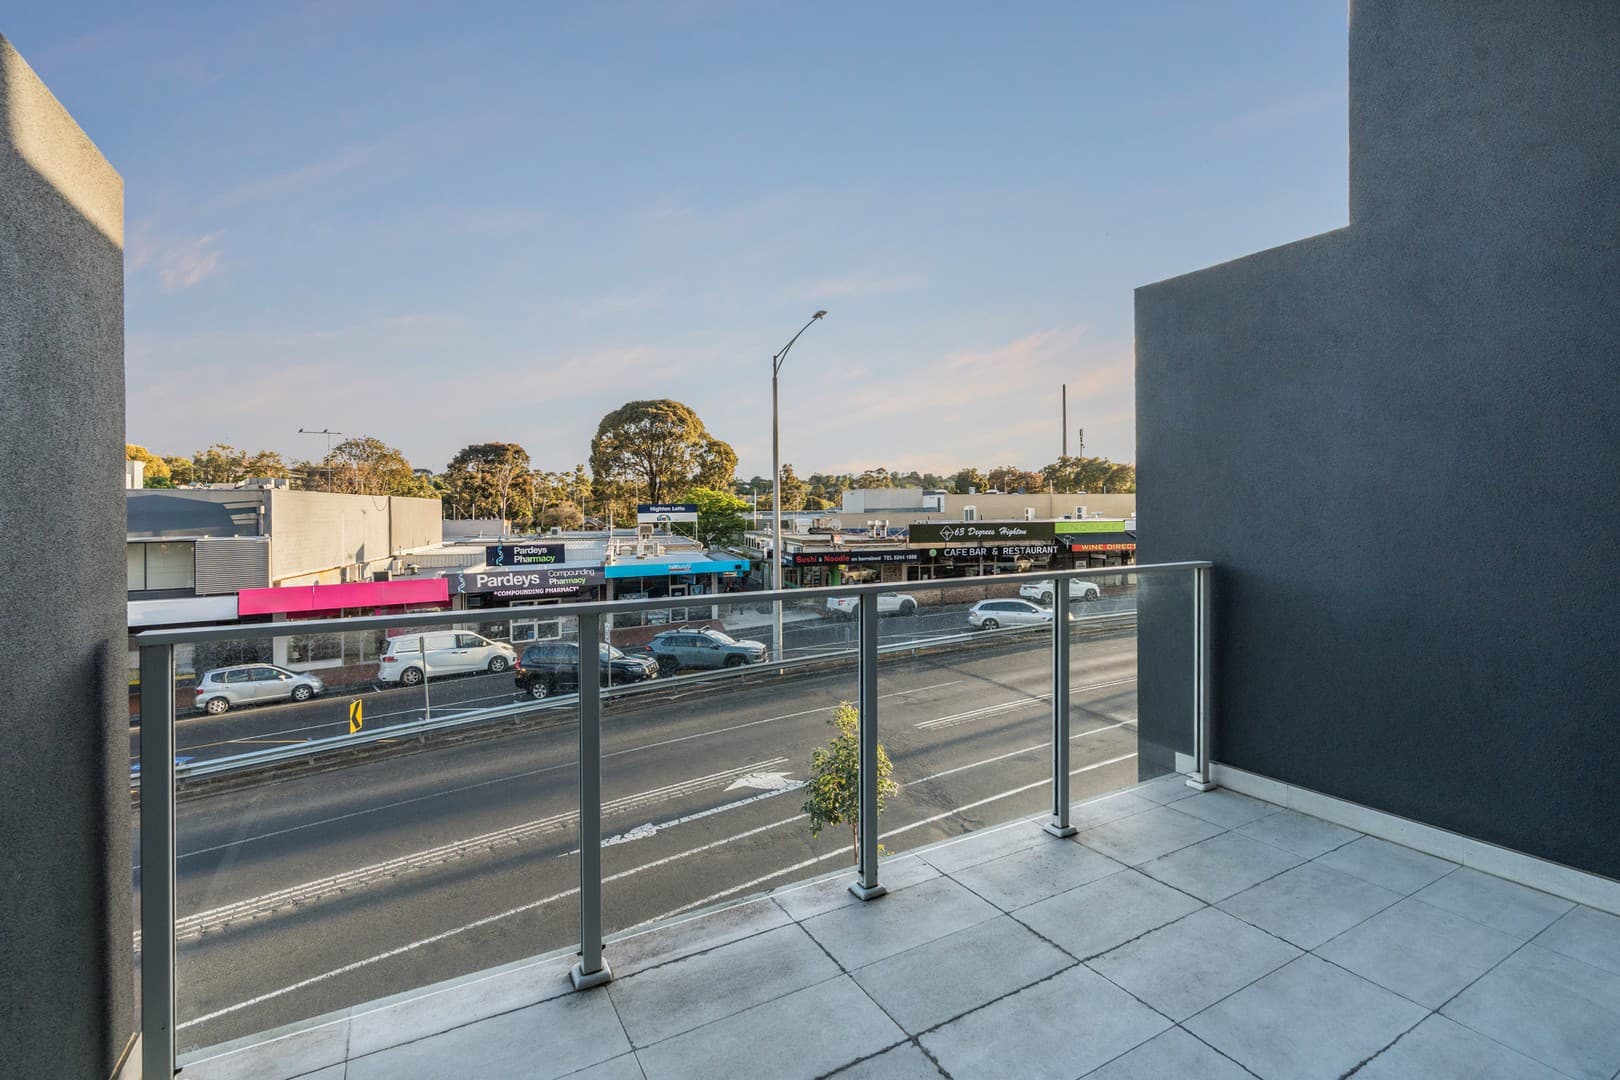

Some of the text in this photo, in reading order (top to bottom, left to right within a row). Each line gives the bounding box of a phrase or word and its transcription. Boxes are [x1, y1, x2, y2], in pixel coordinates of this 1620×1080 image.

[954, 527, 965, 536] 63
[968, 526, 995, 537] Degrees
[513, 546, 547, 555] Pardeys
[943, 545, 1059, 557] CAFE BAR & RESTAURANT
[514, 555, 555, 563] Pharmacy
[824, 554, 850, 563] Noodle
[547, 569, 595, 577] Compounding
[476, 573, 540, 588] Pardeys
[548, 577, 586, 585] Pharmacy
